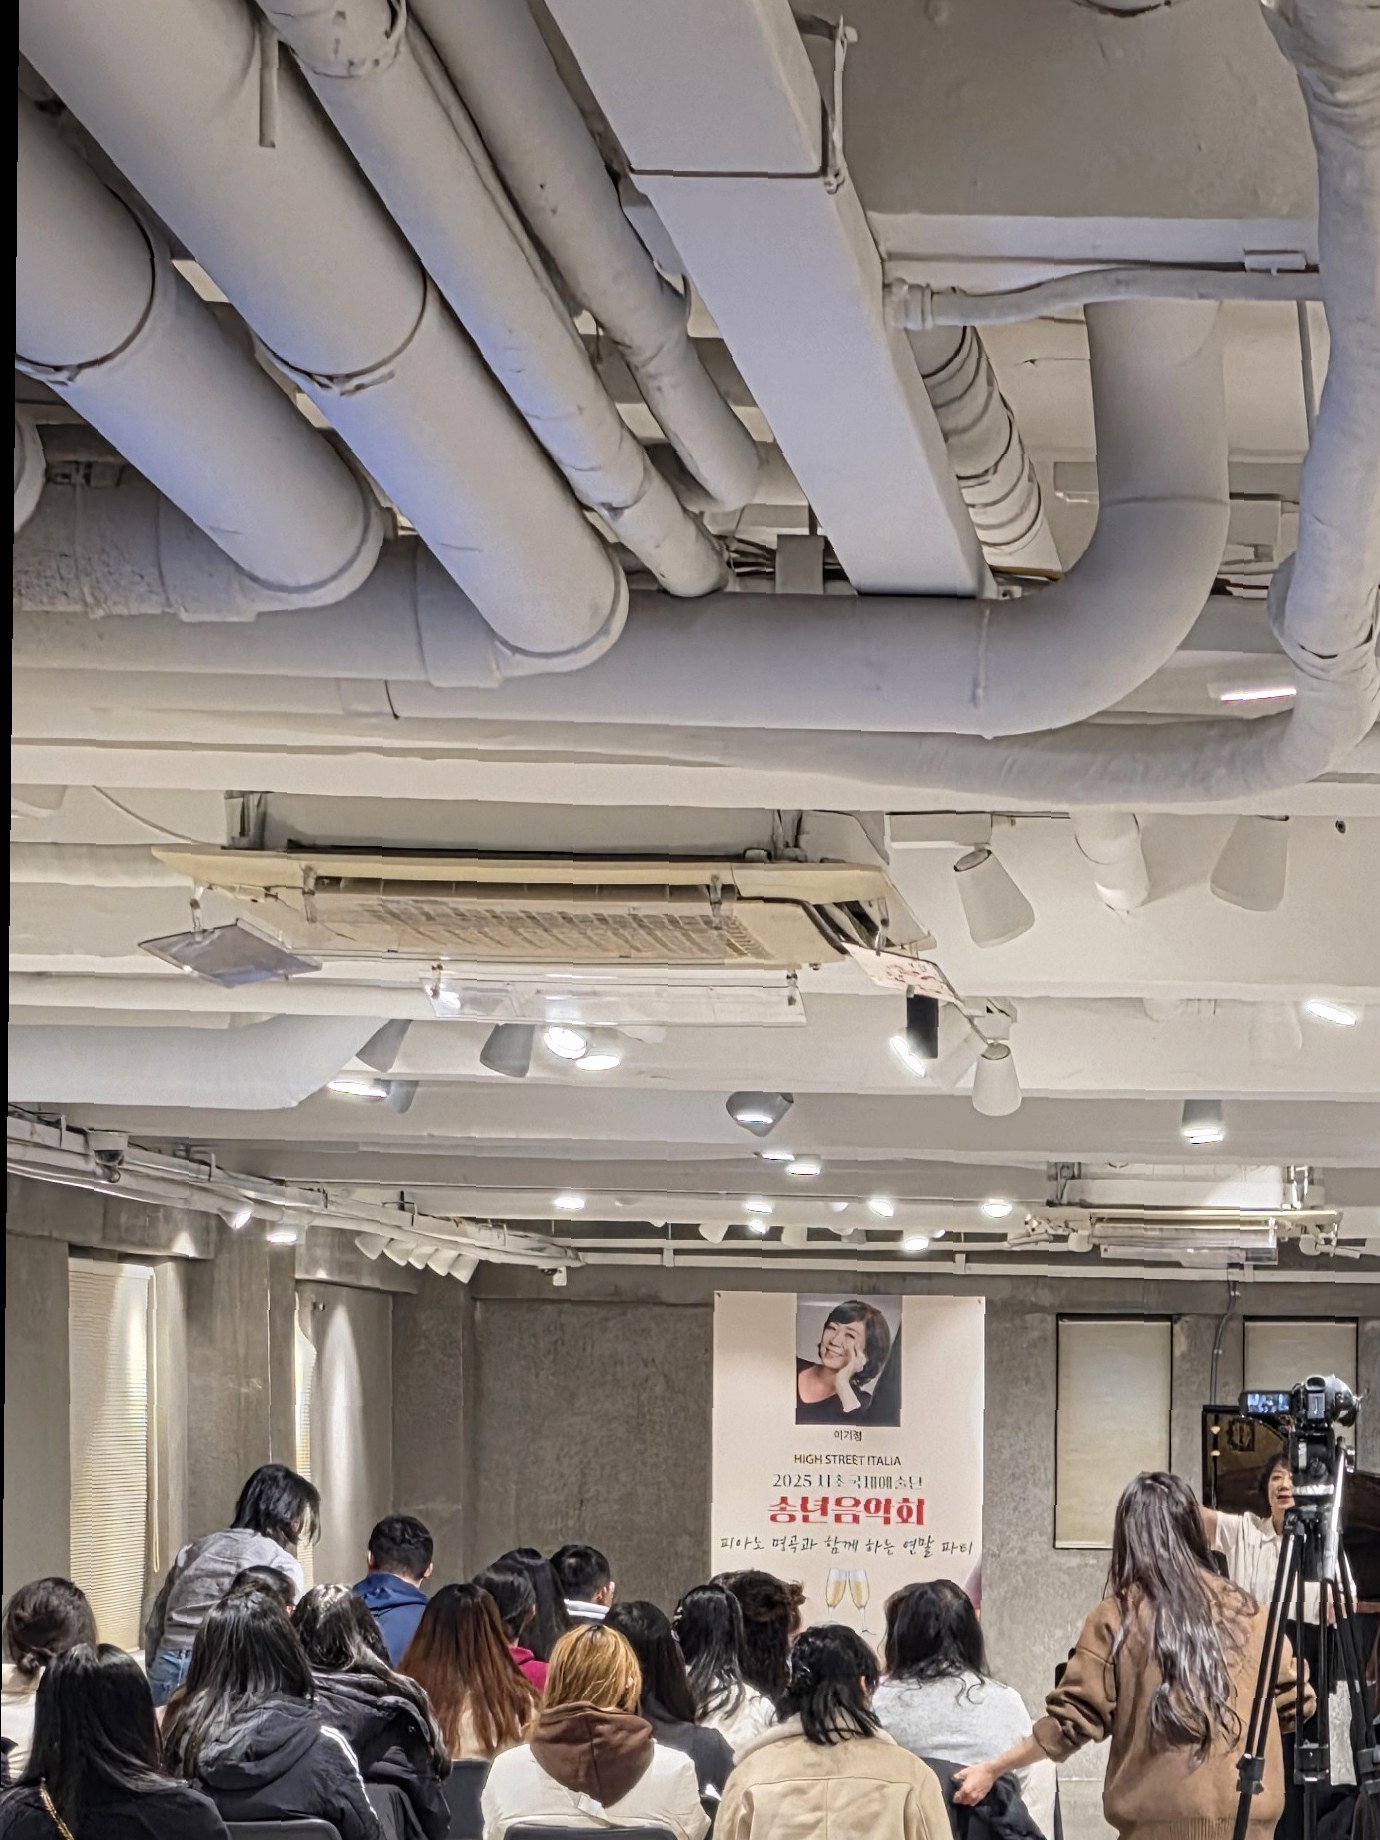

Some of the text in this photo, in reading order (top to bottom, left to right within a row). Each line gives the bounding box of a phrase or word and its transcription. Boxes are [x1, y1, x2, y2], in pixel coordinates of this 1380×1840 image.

[794, 1454, 901, 1466] HIGH STREET ITALIA
[772, 1474, 812, 1487] 2025
[768, 1496, 925, 1526] 송년음악회
[720, 1535, 973, 1558] 피아노 명곡과 함께 하는 연말 파티
